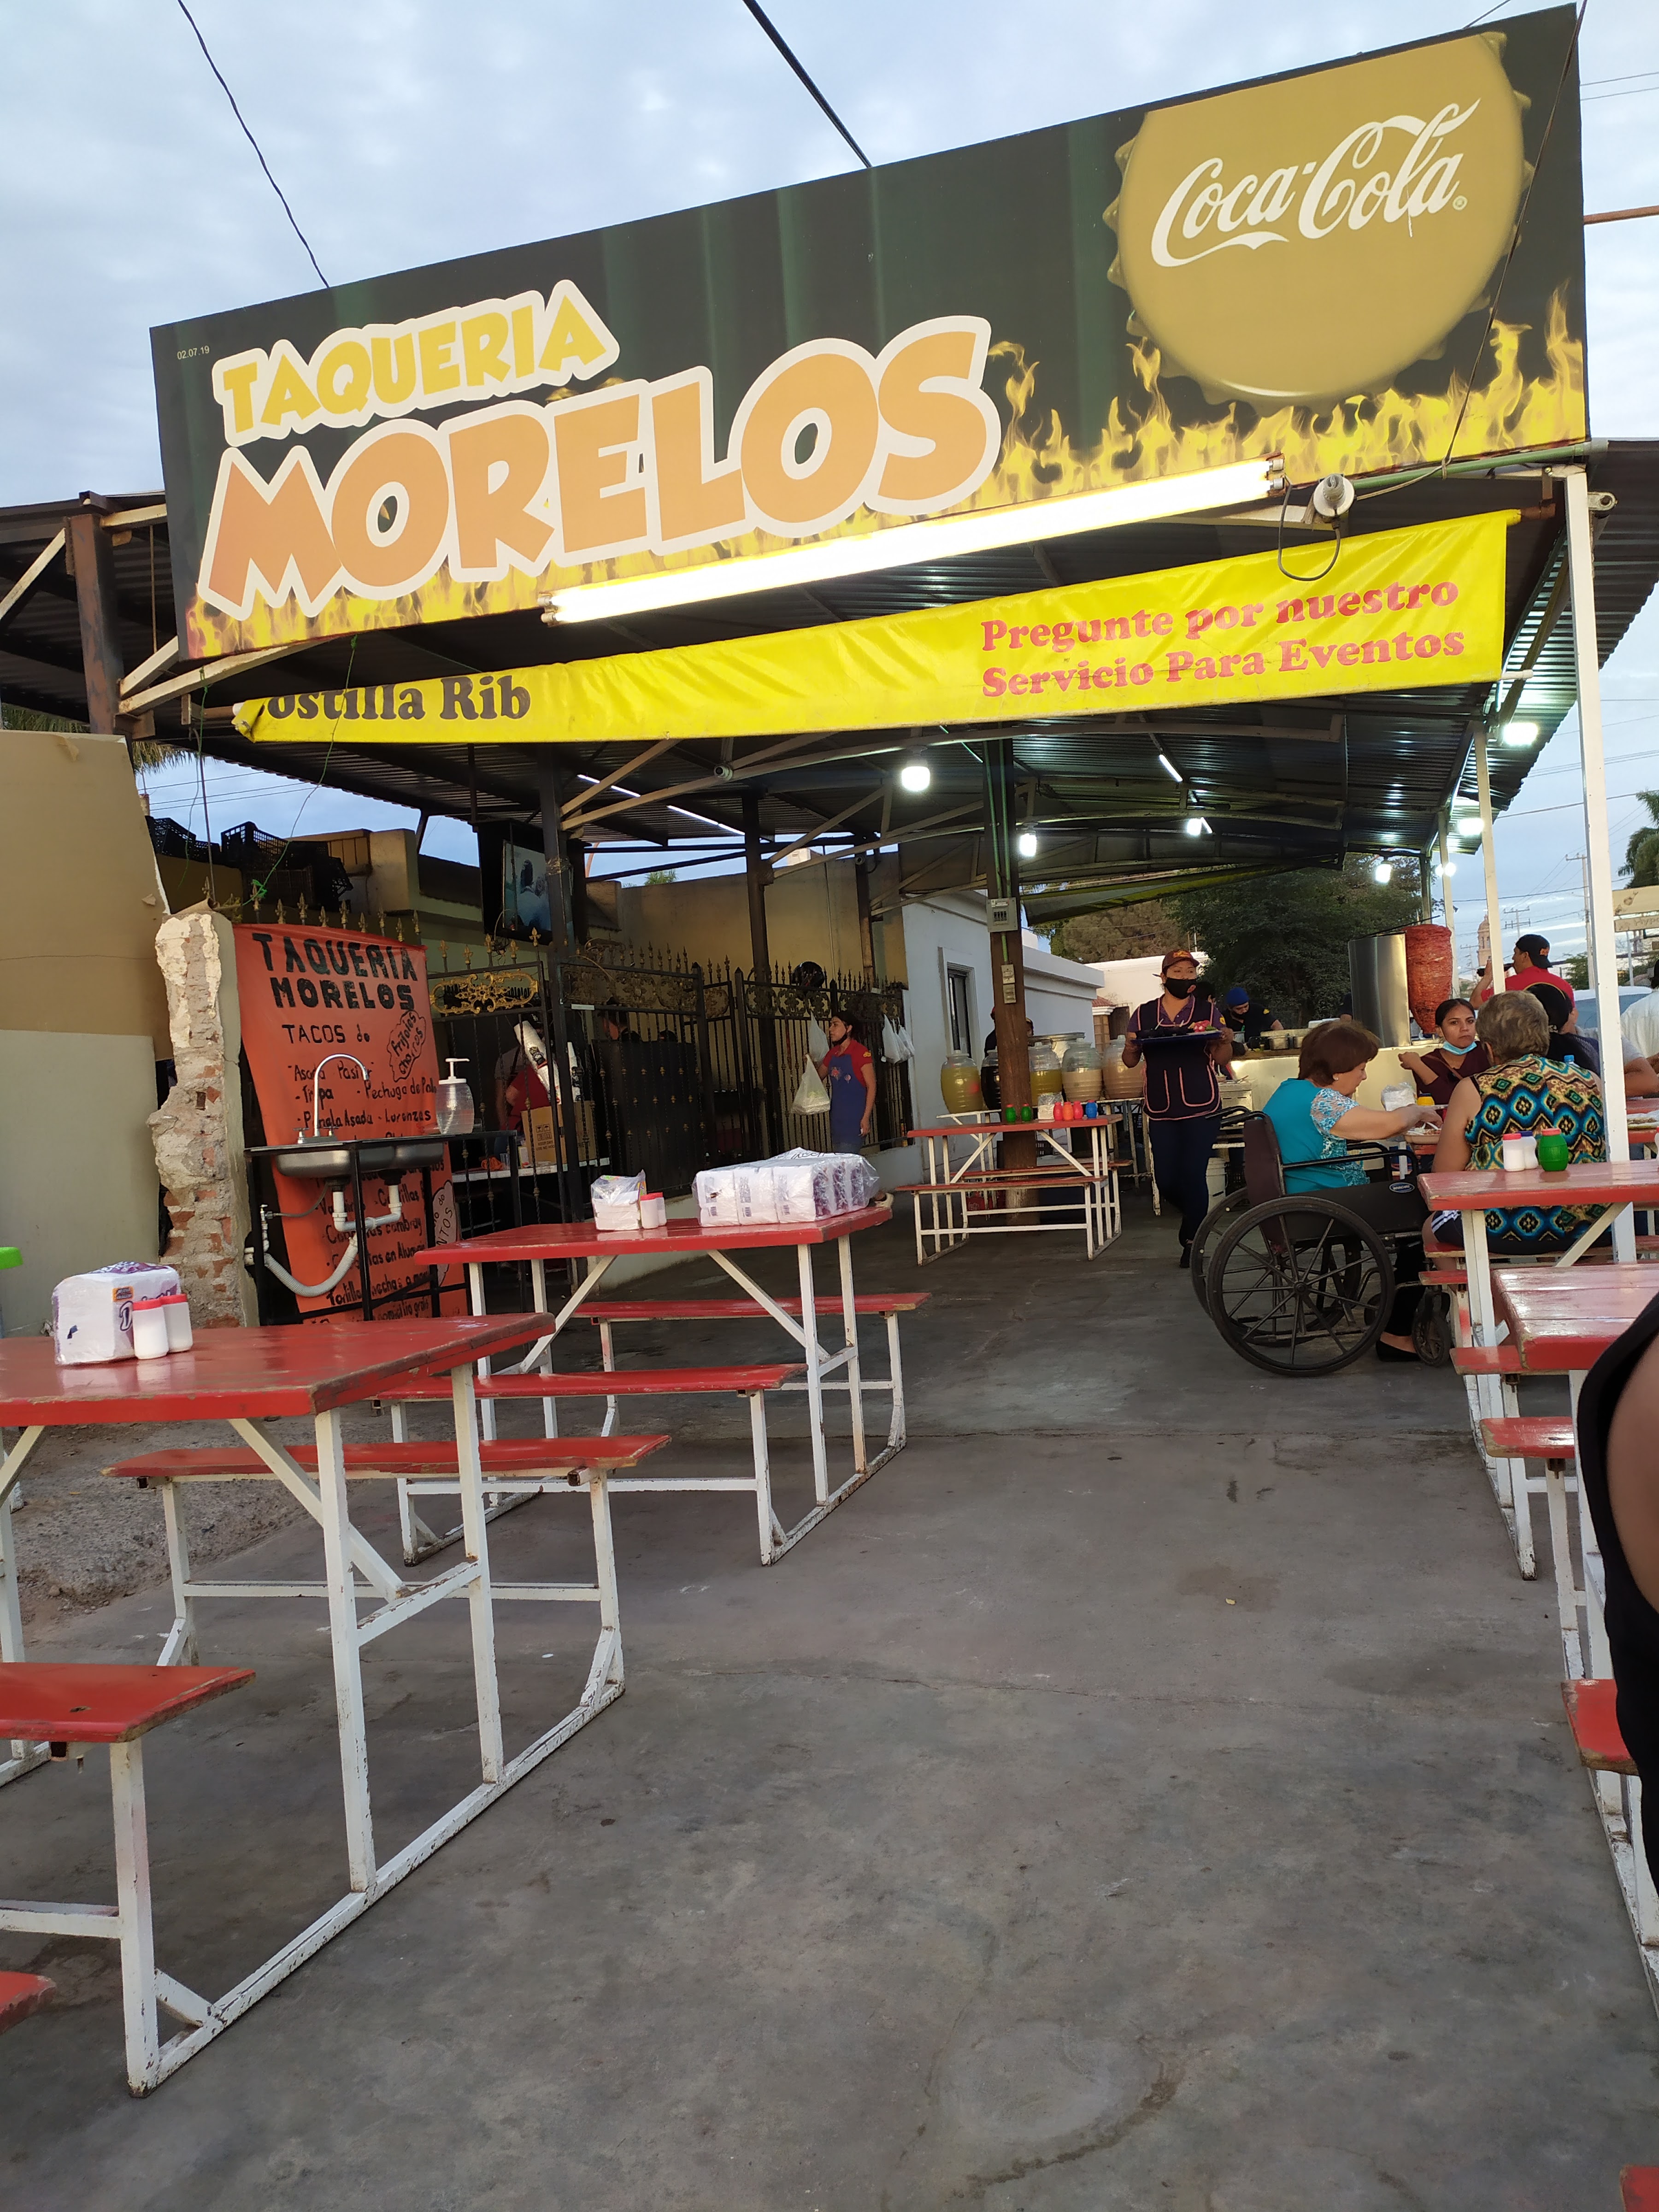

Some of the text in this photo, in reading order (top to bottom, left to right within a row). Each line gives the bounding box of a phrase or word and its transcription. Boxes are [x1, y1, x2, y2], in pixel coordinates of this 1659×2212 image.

[1151, 98, 1481, 267] Coca-Cola
[177, 345, 210, 360] 02.07.19
[221, 292, 609, 435] TAQUERIA
[206, 329, 989, 608] MORELOS
[981, 580, 1459, 653] Pregunte por nuestro
[982, 630, 1465, 698] Servicio Para Eventos
[263, 675, 531, 720] ostilla Rib
[252, 932, 418, 982] TAQUERIA
[270, 977, 415, 1011] MORELOS
[282, 1024, 346, 1044] TACOS
[302, 1084, 334, 1110] Trpa
[364, 1079, 407, 1100] Pechuga
[303, 1108, 343, 1128] Pnela
[344, 1109, 373, 1127] Asada
